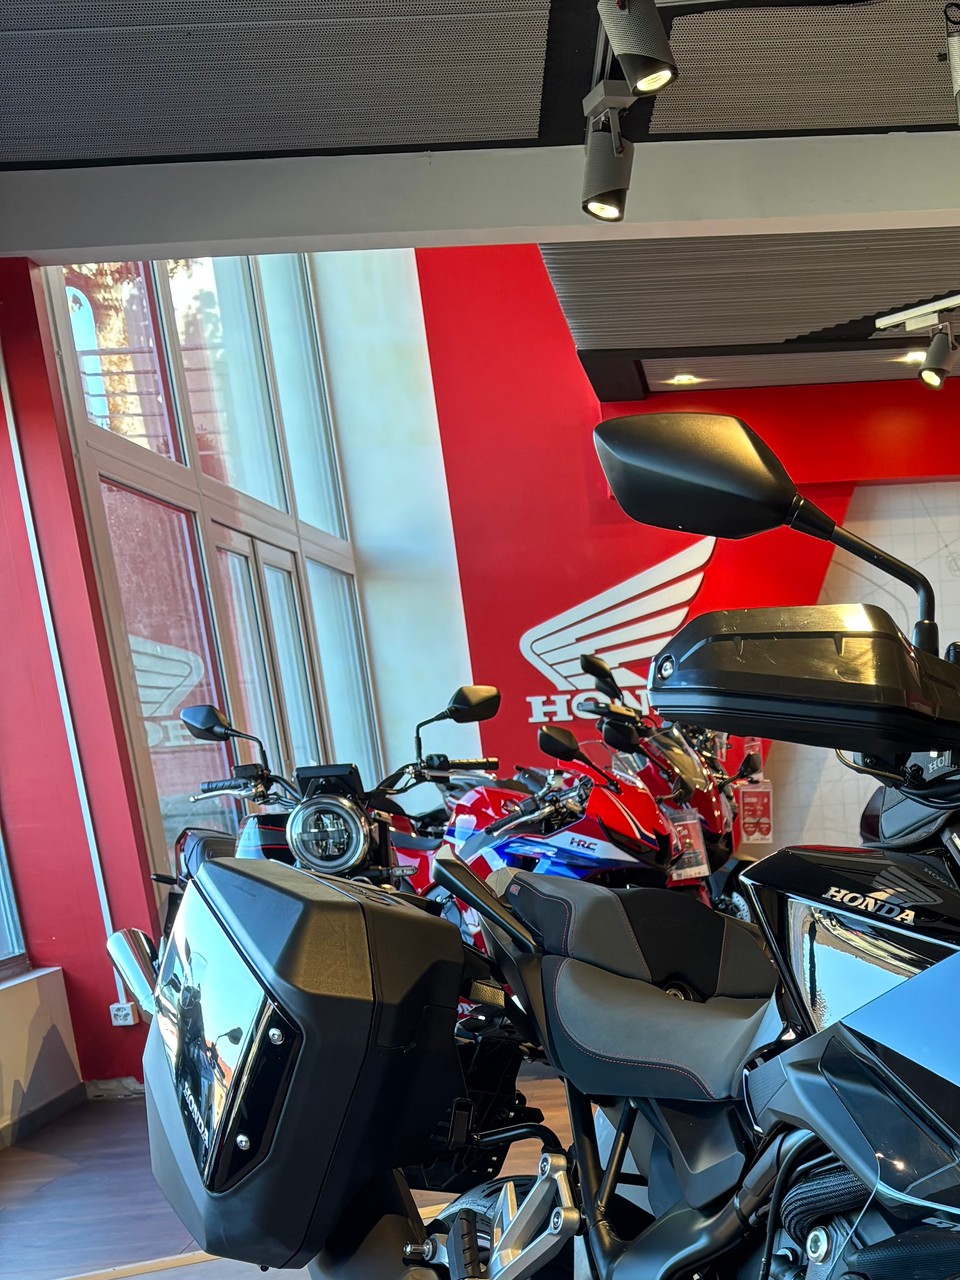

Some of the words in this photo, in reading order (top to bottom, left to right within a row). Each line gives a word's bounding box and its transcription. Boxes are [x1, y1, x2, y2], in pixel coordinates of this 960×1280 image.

[569, 837, 597, 851] HRC
[822, 886, 915, 926] HONDA
[183, 1081, 209, 1149] HONDA
